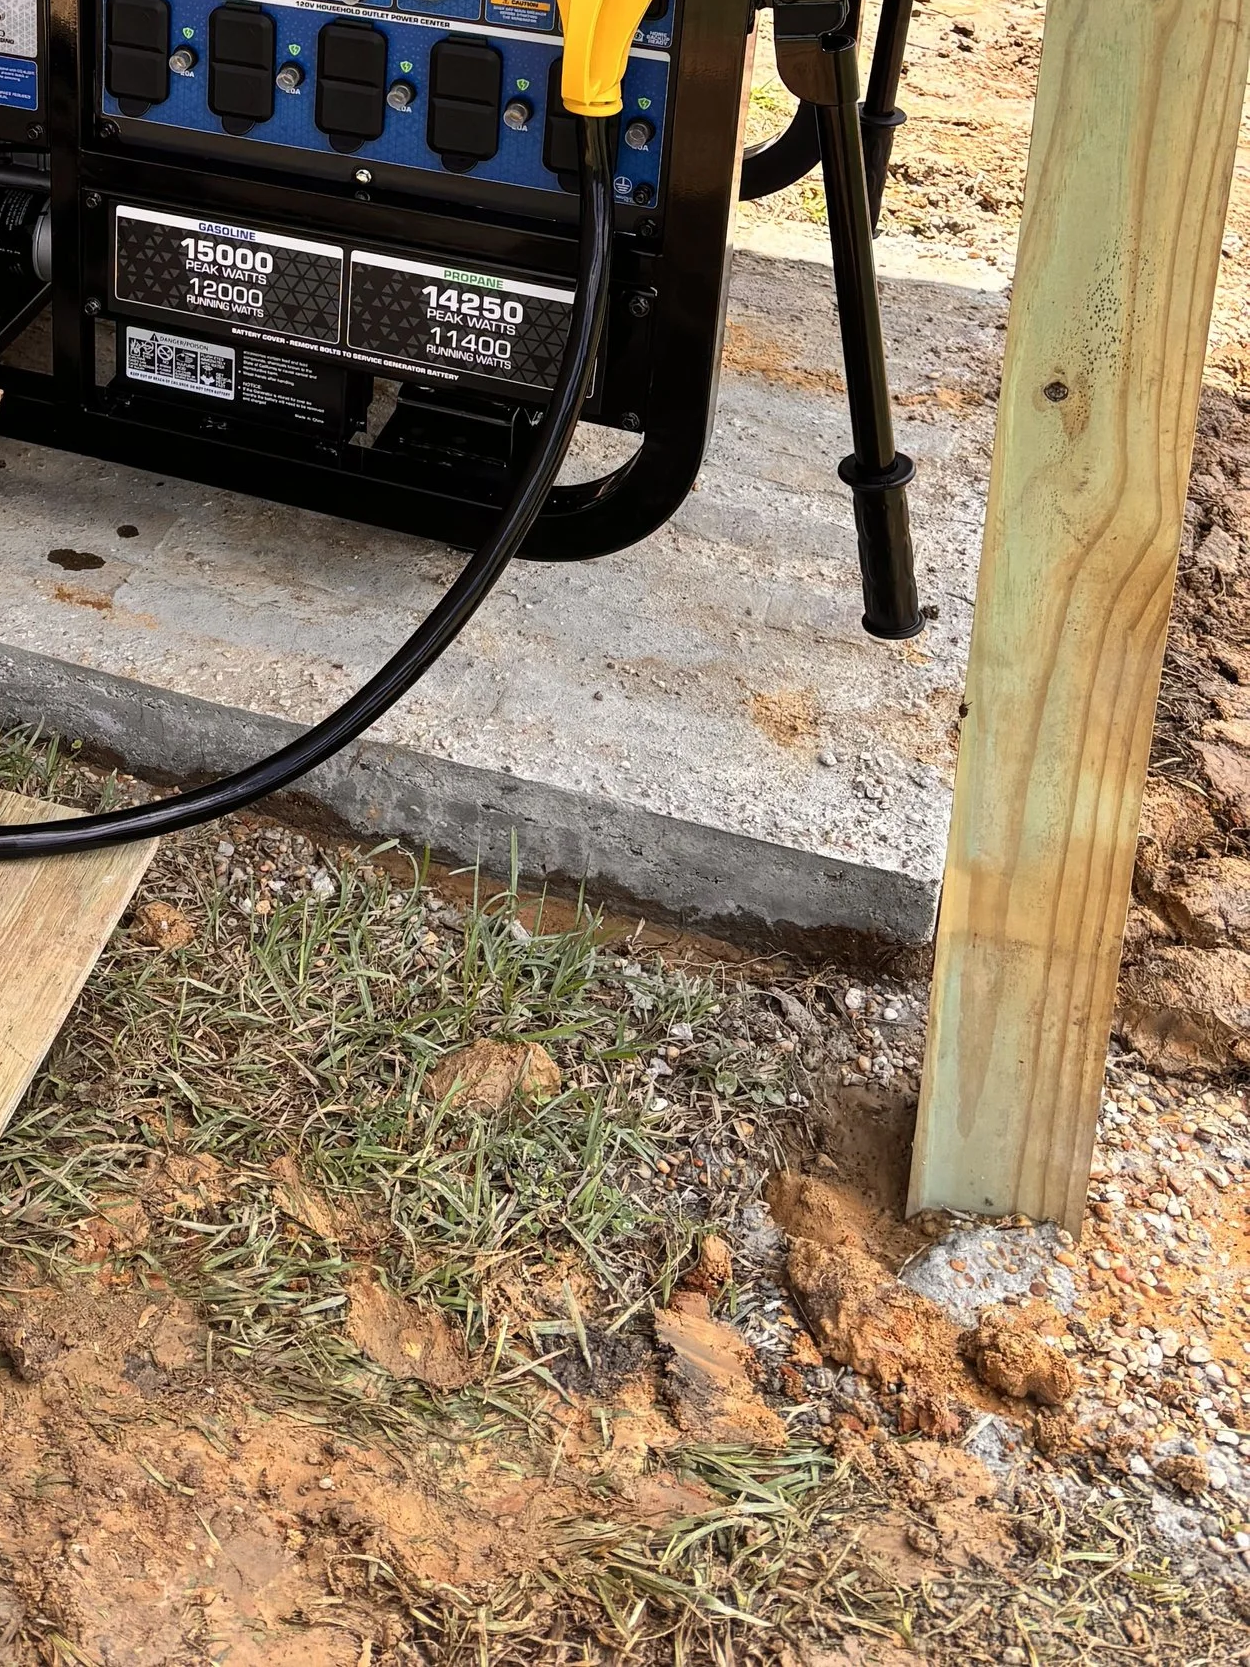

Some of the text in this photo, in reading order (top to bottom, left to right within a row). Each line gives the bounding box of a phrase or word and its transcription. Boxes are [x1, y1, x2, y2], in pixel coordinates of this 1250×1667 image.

[296, 0, 451, 28] 120V HOUSEHOLD OUTLET POWER CENTER
[511, 0, 539, 9] CAUTION
[199, 222, 256, 241] GASOLINE
[180, 237, 274, 274] 15000
[186, 259, 267, 285] PEAK WATTS
[443, 269, 504, 290] PROPANE
[186, 294, 264, 318] RUNNING WATTS
[190, 277, 263, 308] 12000
[422, 285, 524, 324] 14250
[426, 308, 516, 336] PEAK WATTS
[160, 336, 209, 352] DANGER/POISON
[231, 327, 460, 381] BATTERY COVER REMOVE BOLTS TO SERVICE GENERATOR BATTERY
[430, 326, 511, 359] 11400
[426, 344, 512, 370] RUNNING WATTS
